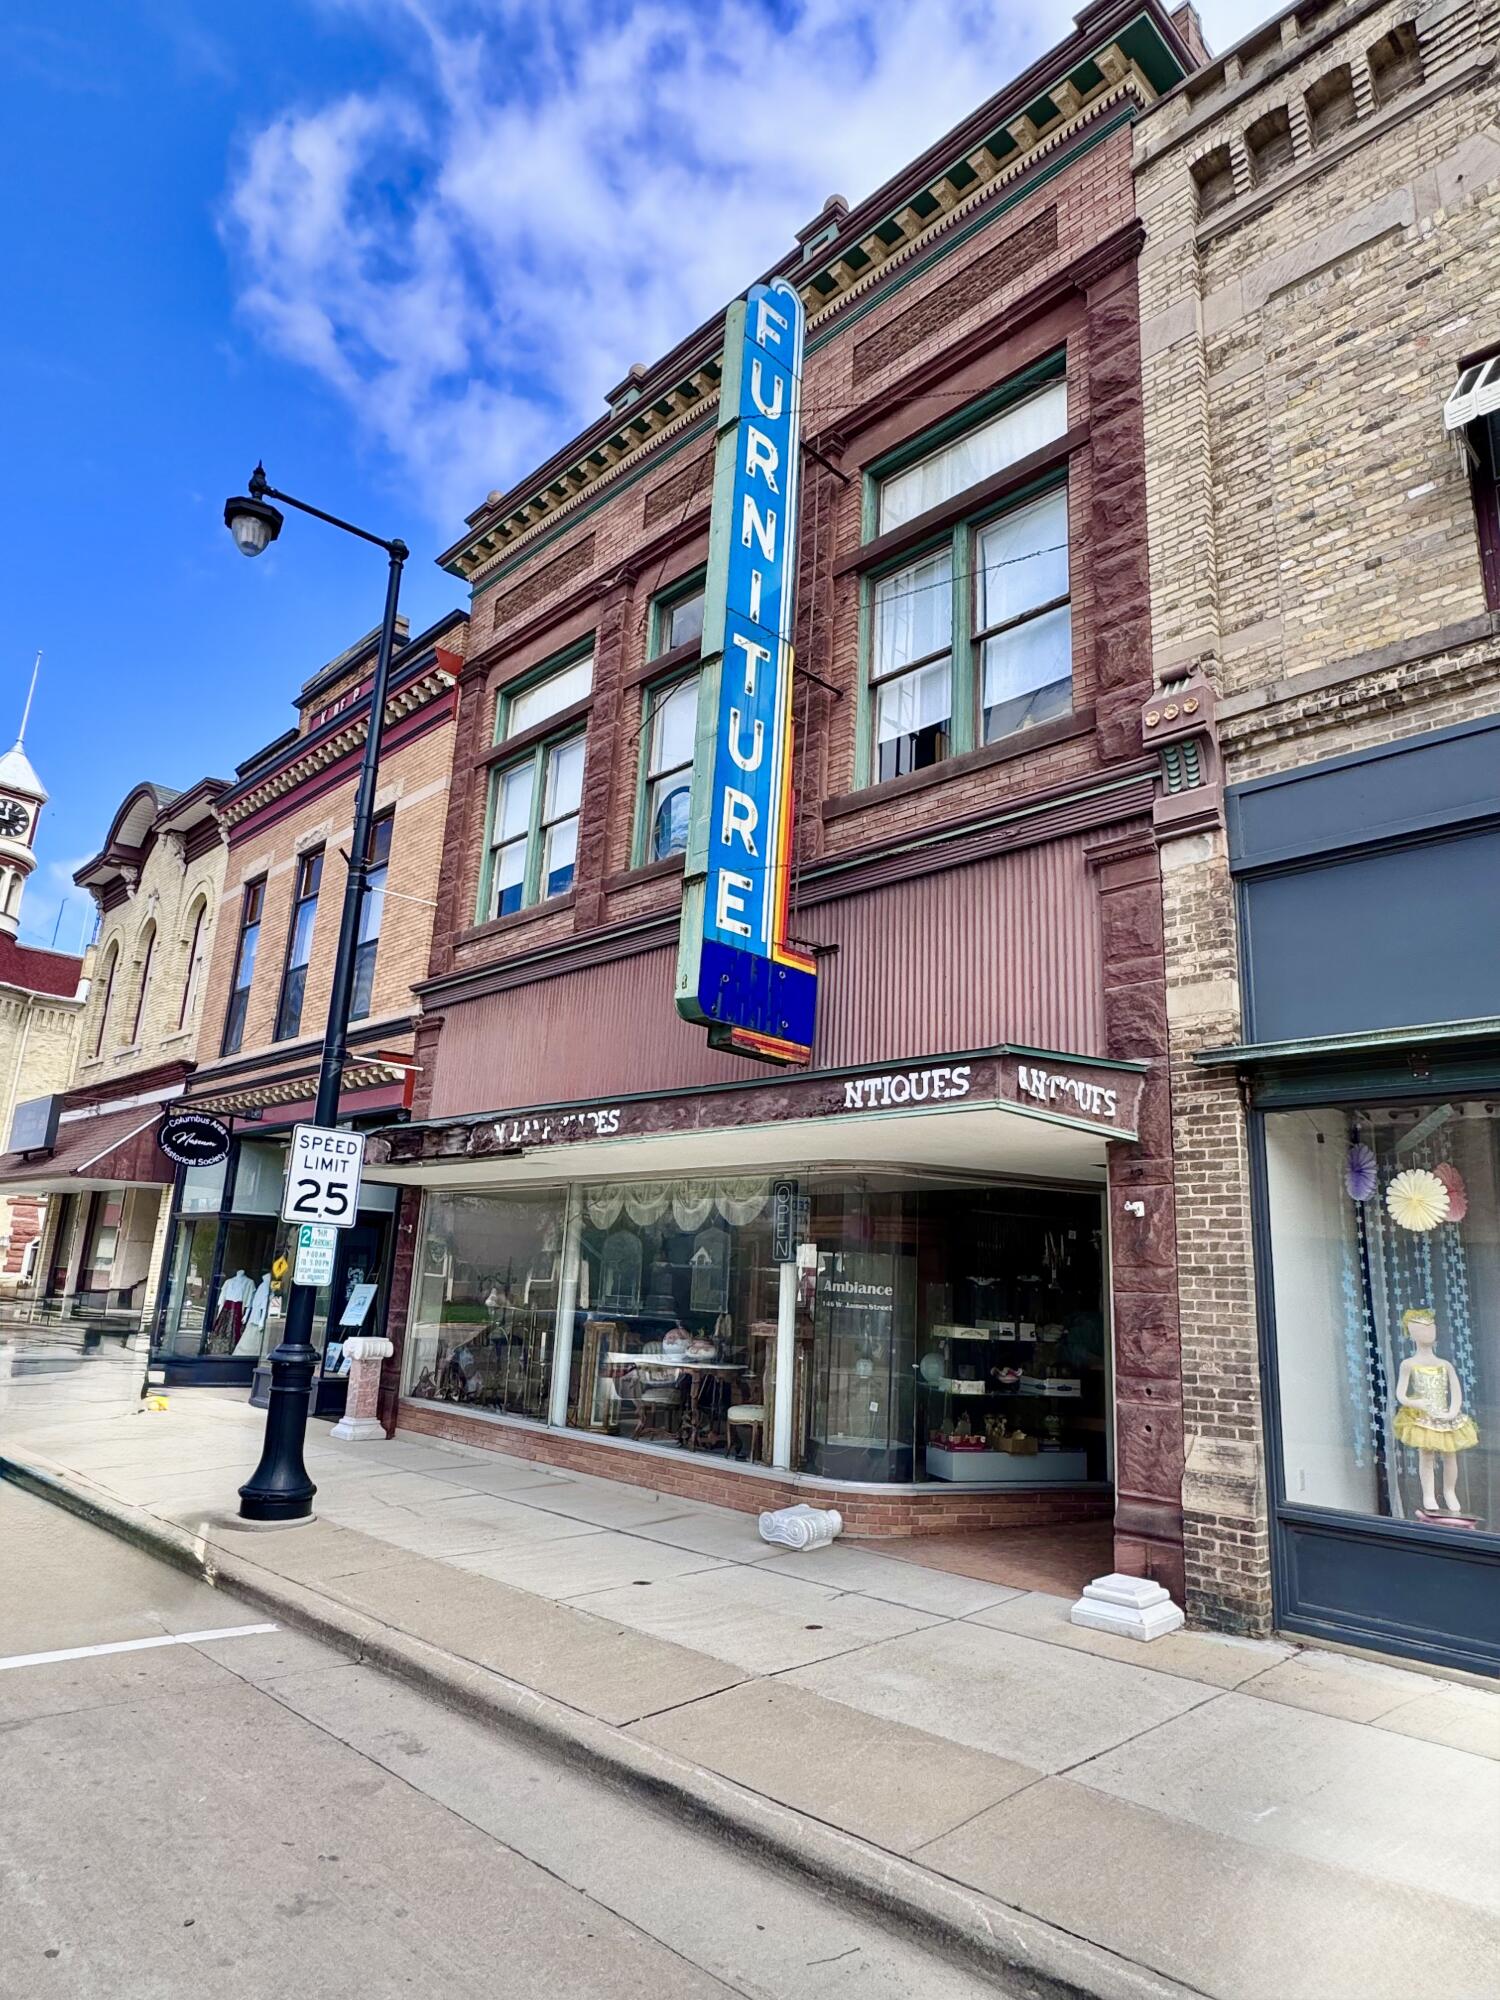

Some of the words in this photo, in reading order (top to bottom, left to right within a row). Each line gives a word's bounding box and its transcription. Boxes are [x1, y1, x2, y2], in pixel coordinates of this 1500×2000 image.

[717, 295, 788, 935] FURNITURE
[352, 687, 360, 703] P
[168, 1115, 210, 1127] Columbus
[210, 1120, 227, 1135] Area
[161, 1143, 197, 1166] Historical
[198, 1151, 226, 1166] Society
[299, 1135, 358, 1155] SPEED
[304, 1155, 350, 1173] LIMIT
[293, 1178, 349, 1216] 25
[776, 1186, 790, 1257] OPEN
[301, 1229, 311, 1244] 2
[823, 1280, 893, 1296] Ambiance
